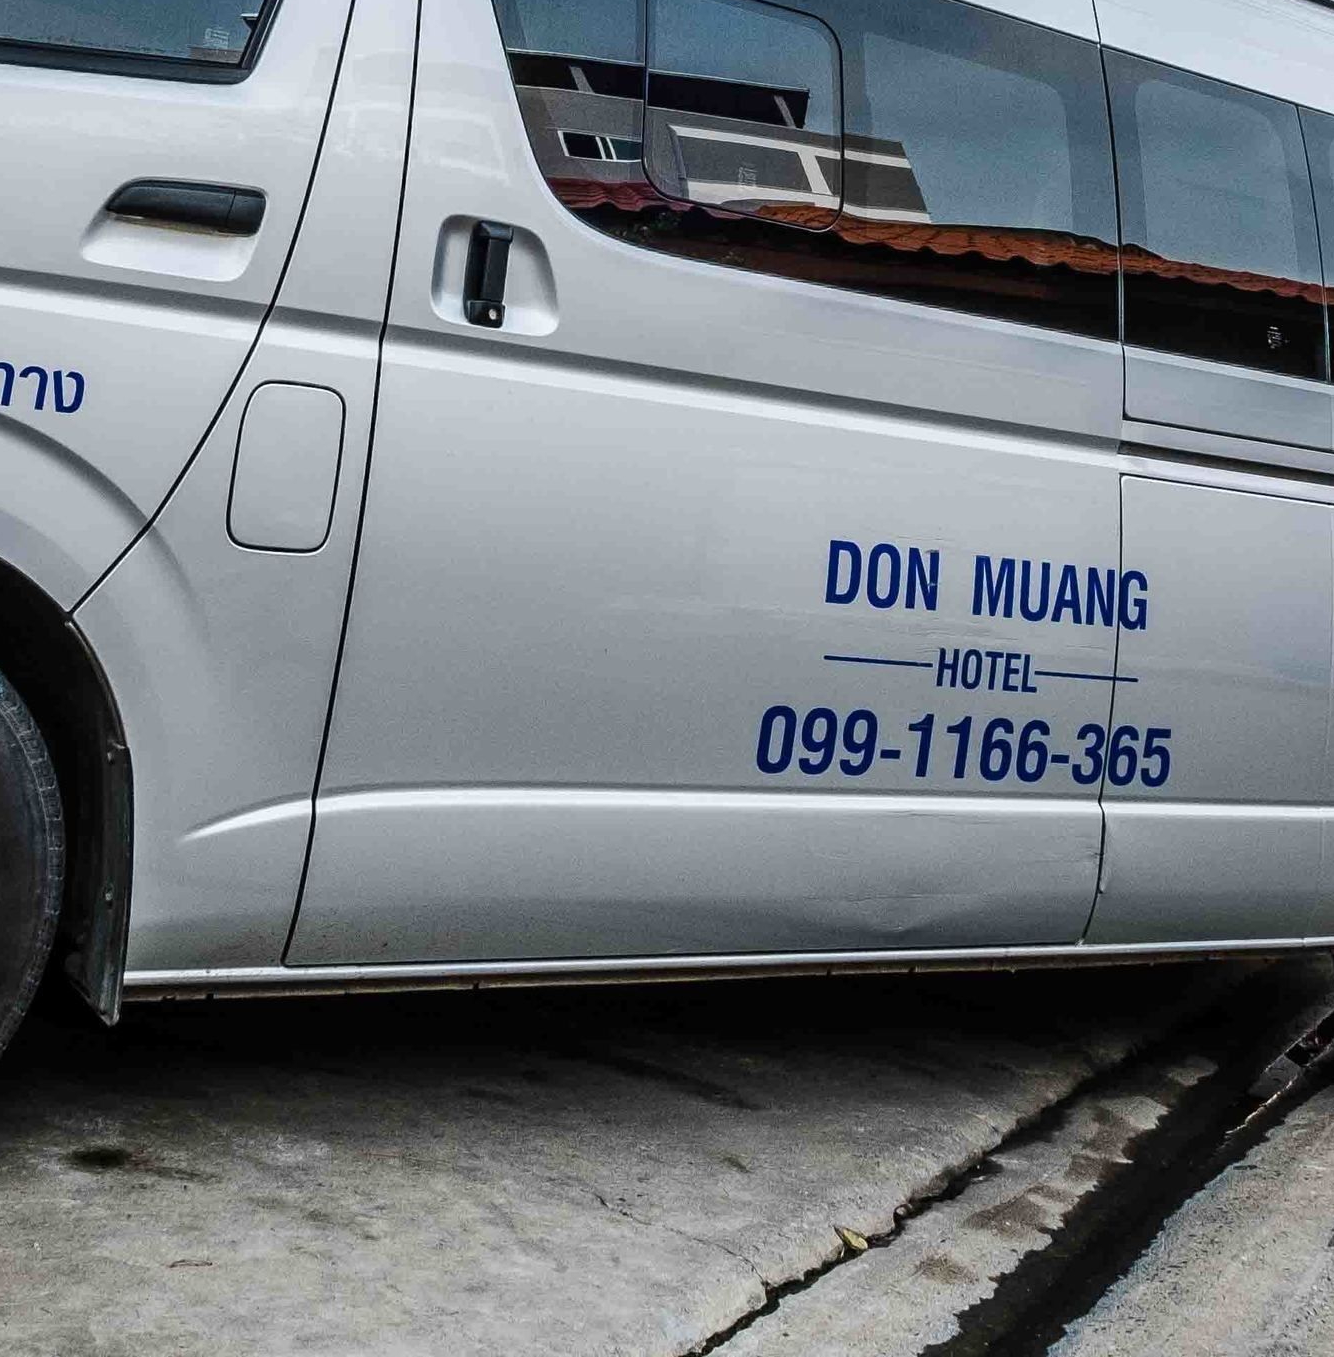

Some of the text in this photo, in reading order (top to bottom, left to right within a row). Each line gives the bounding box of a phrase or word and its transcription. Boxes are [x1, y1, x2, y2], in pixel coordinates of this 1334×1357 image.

[824, 539, 1148, 631] DON MUANG
[935, 647, 1037, 693] HOTEL
[755, 704, 1172, 788] 099-1166-365
